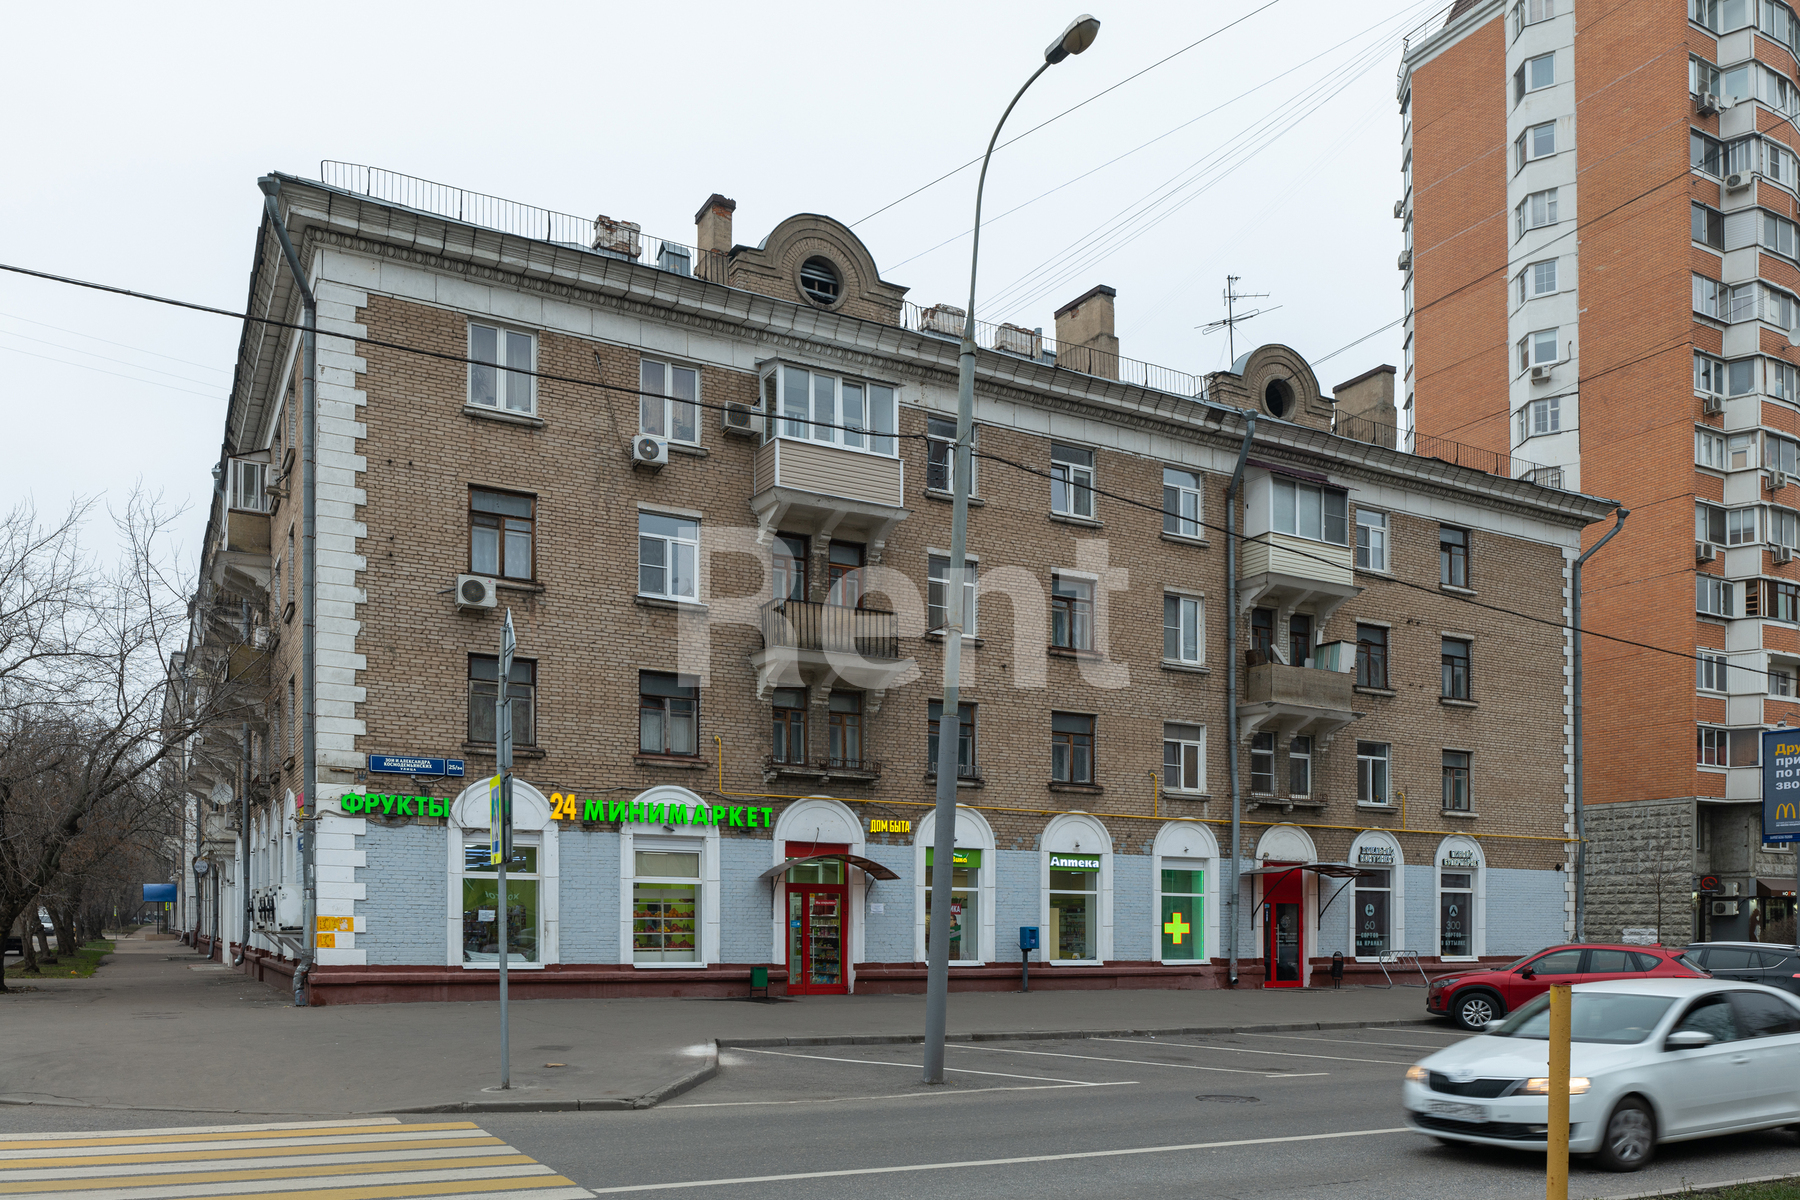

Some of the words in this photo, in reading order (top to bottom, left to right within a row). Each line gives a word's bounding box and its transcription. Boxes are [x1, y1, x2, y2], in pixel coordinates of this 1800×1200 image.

[341, 792, 450, 818] ФРУКТЫ
[550, 792, 577, 820] 24
[584, 799, 773, 827] МИНИМАРКЕТ
[870, 820, 888, 832] ДОМ
[889, 820, 910, 832] БЫТА
[1050, 856, 1099, 868] Аптека
[1364, 920, 1376, 930] 60
[1446, 920, 1460, 930] 300
